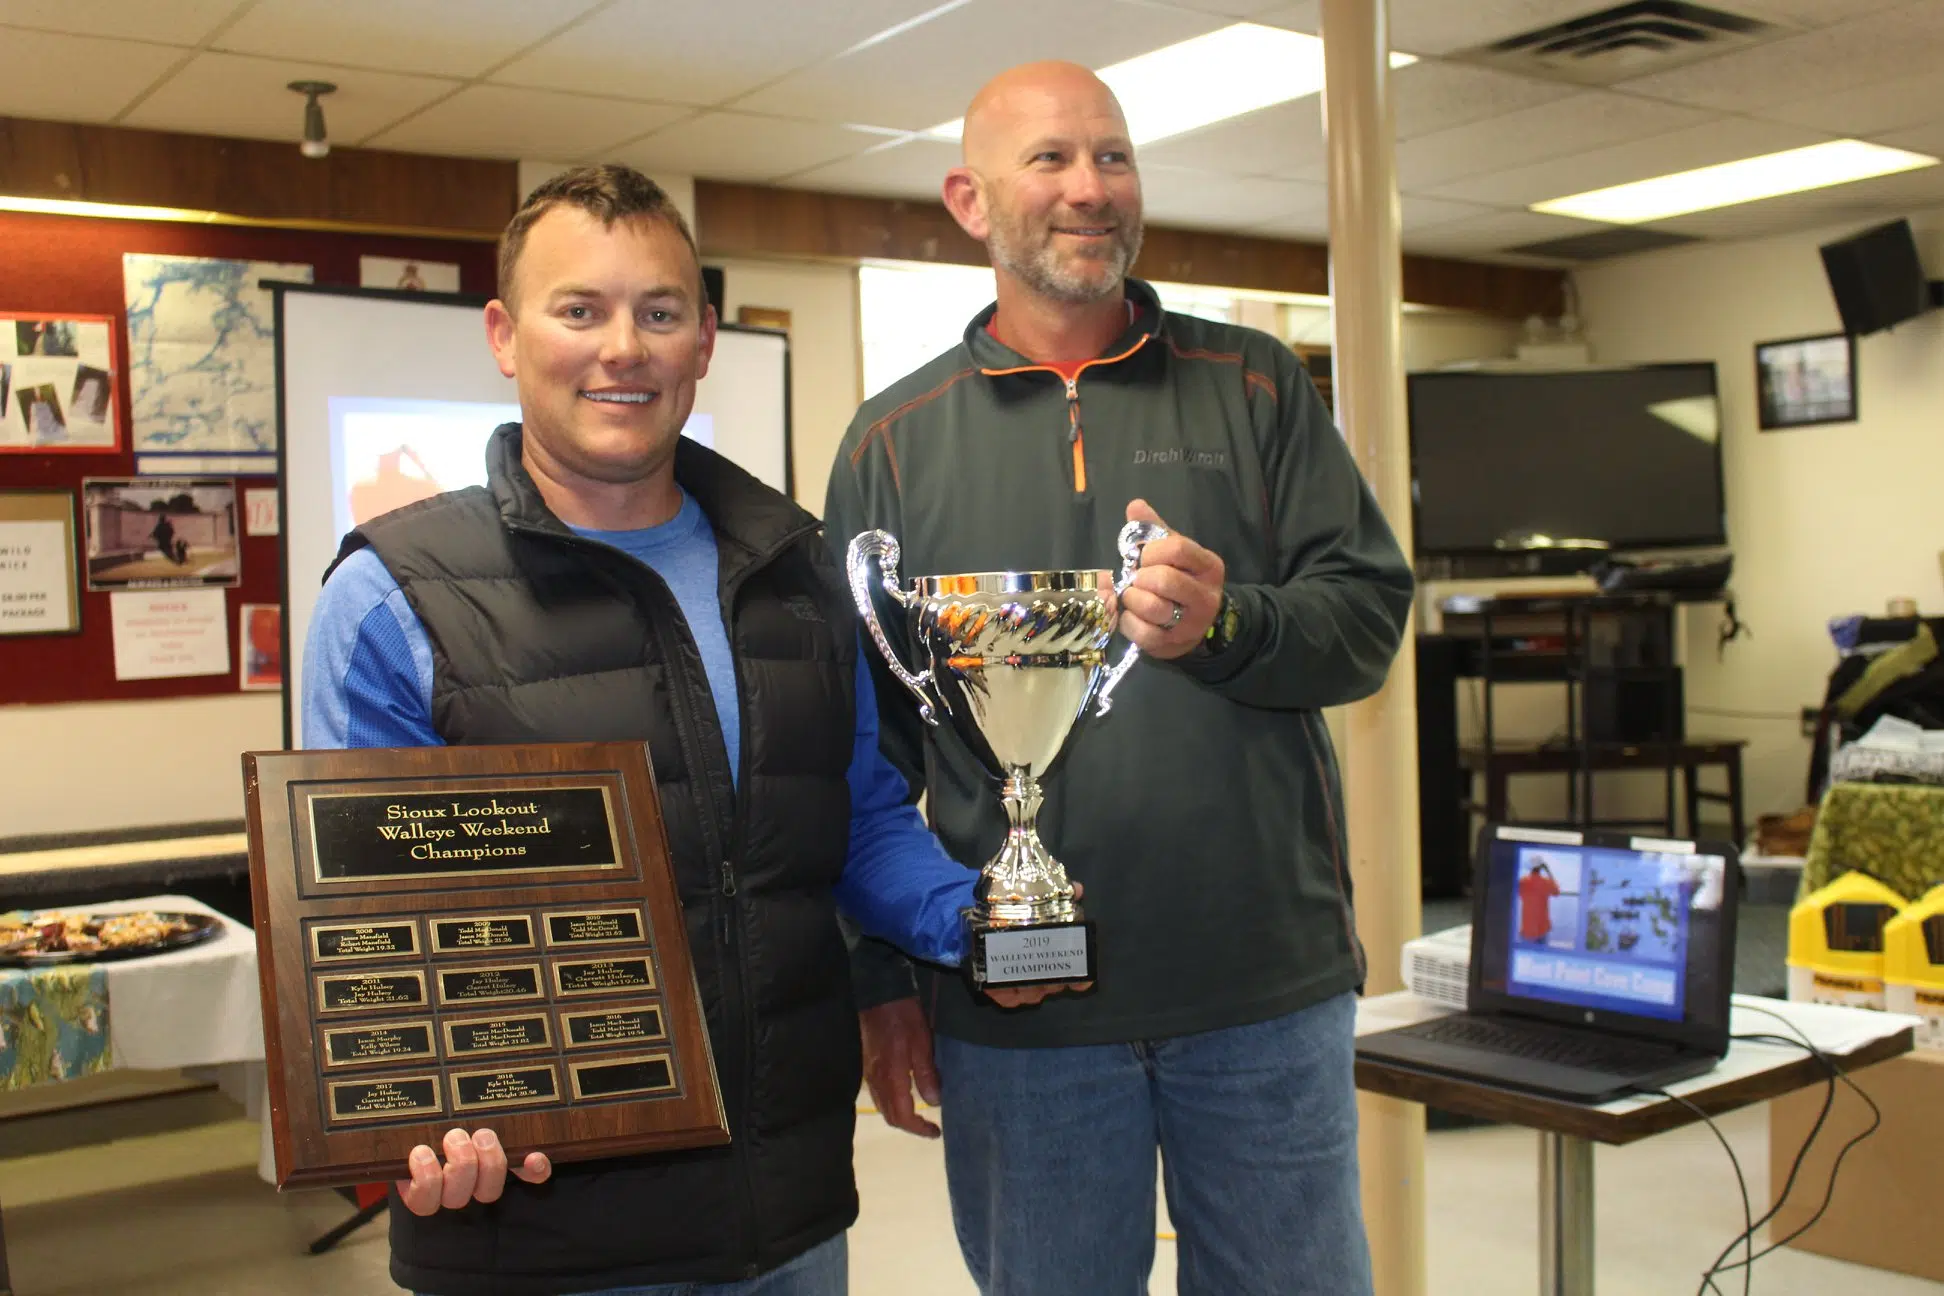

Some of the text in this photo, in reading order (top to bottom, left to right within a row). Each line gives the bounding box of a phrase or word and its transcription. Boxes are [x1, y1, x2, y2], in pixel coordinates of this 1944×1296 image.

[387, 800, 538, 819] Sioux Lookout
[377, 818, 551, 841] Walleye Weekend
[411, 843, 526, 860] Champions
[1023, 936, 1050, 948] 2019
[991, 950, 1083, 962] WALLEYE WEEKEND
[1004, 962, 1071, 975] CHAMPIONS
[607, 1018, 640, 1026] MacDonald
[491, 1026, 525, 1034] MacDonald
[491, 1032, 525, 1040] MacDonald
